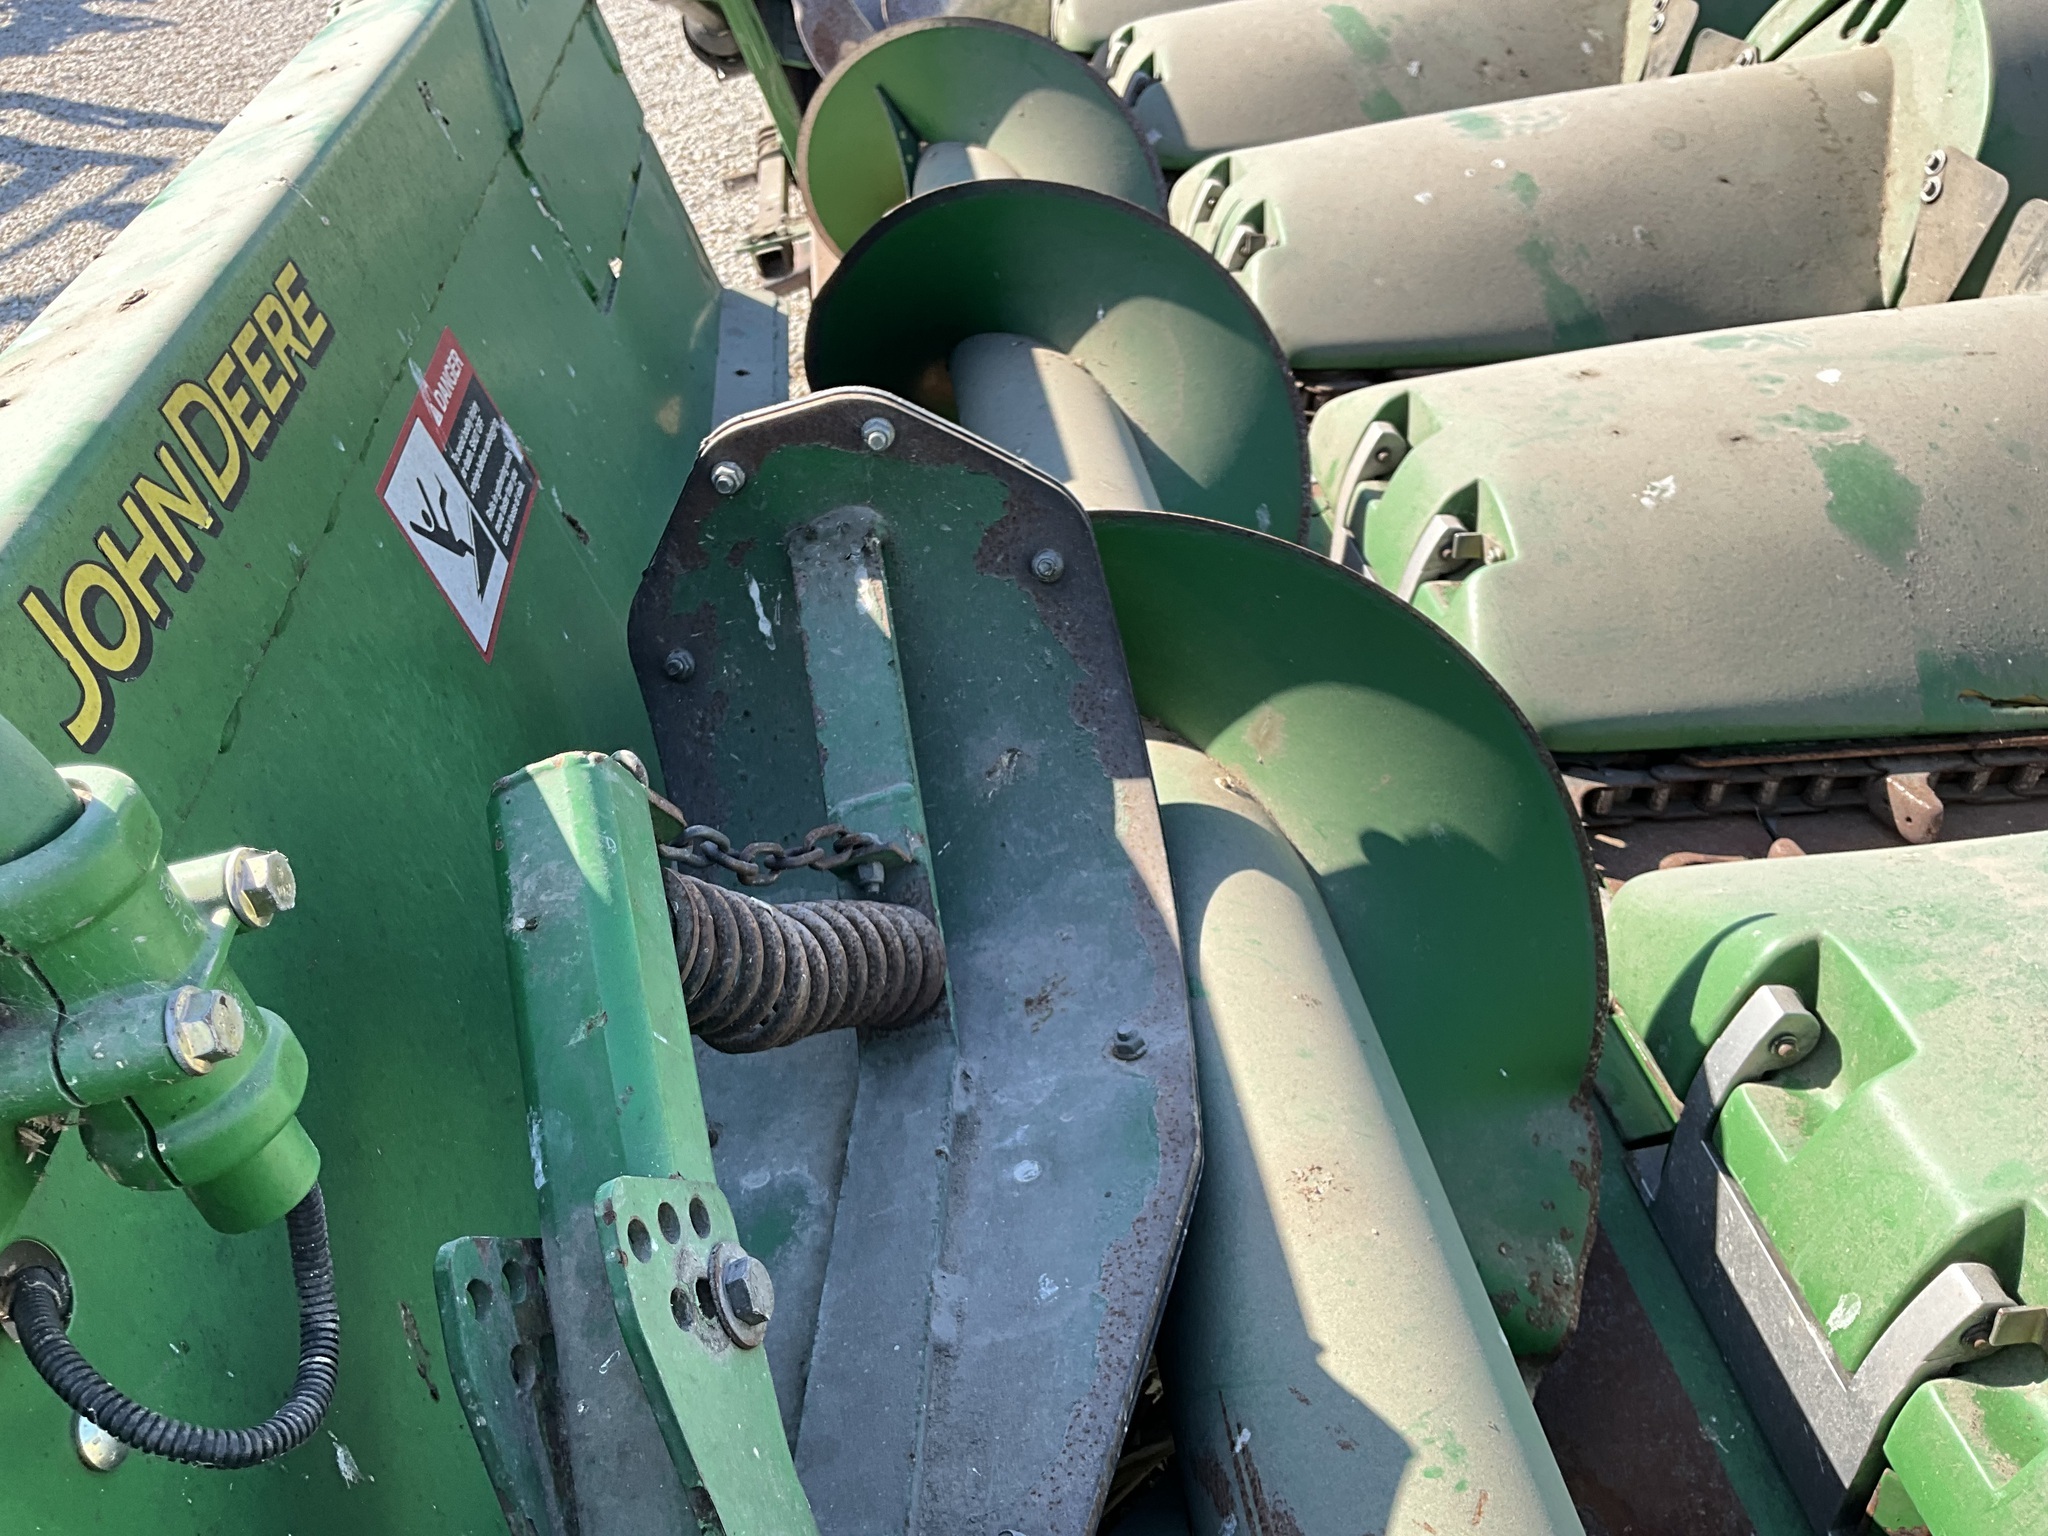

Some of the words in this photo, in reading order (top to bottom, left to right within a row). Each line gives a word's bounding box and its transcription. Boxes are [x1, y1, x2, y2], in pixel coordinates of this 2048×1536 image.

[433, 349, 464, 412] DANGER
[20, 442, 219, 750] JOHN
[161, 259, 331, 508] DEERE
[158, 874, 182, 917] USA
